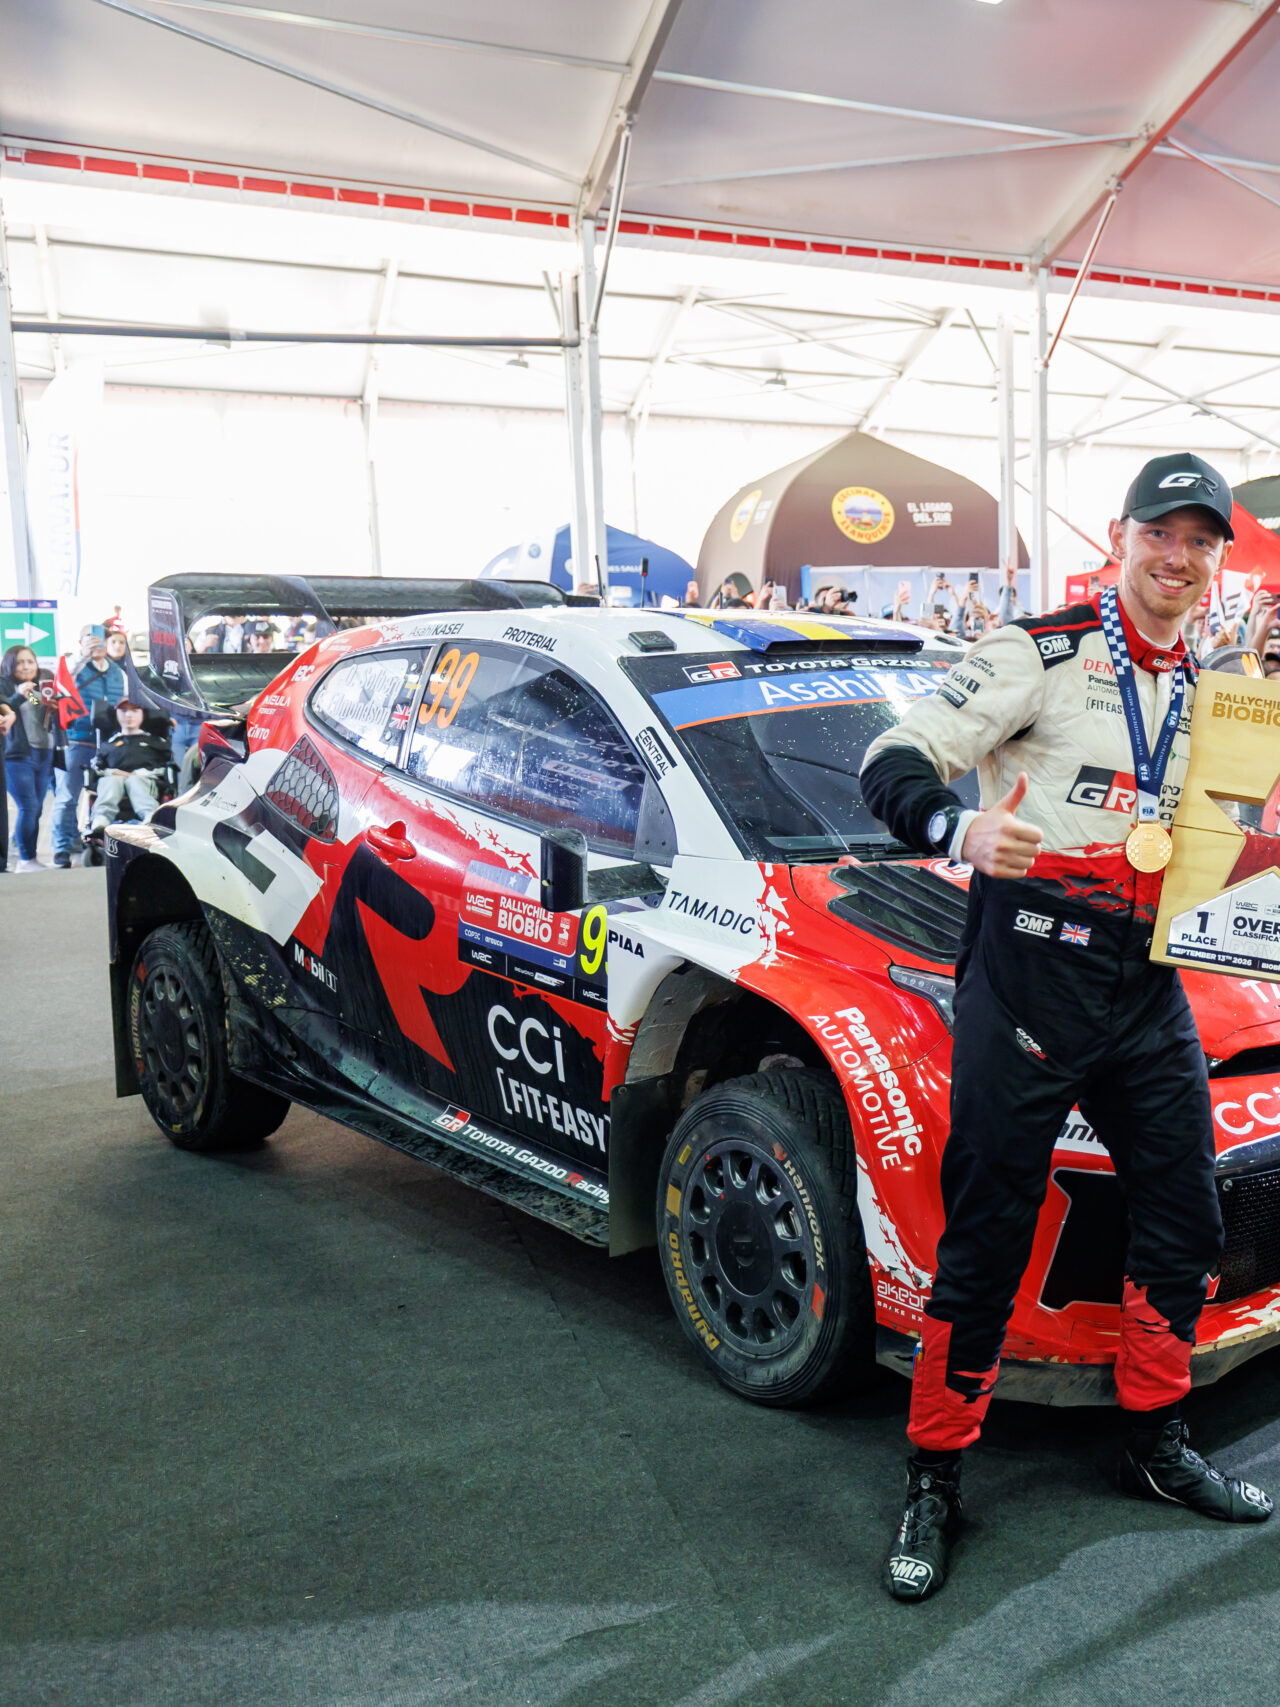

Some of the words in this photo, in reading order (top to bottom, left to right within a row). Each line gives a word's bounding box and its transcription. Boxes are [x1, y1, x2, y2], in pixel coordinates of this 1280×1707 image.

[1158, 471, 1219, 497] GR
[433, 623, 464, 635] KASEI
[502, 626, 557, 652] PROTERIAL
[1040, 636, 1072, 656] OMP
[691, 666, 739, 682] GR
[745, 659, 843, 674] TOYOTA
[850, 657, 931, 673] GAZOO
[418, 648, 480, 729] 99
[759, 673, 872, 705] Asahi
[872, 672, 953, 703] KAS
[1088, 674, 1119, 688] Panaso
[638, 729, 668, 777] CENTRAL
[1069, 781, 1137, 813] GR
[1142, 806, 1155, 816] FIA
[467, 892, 494, 911] WRC
[500, 896, 554, 923] RALLYCHILE
[668, 890, 756, 935] TAMADIC
[1015, 913, 1053, 934] OMP
[580, 905, 608, 975] 9
[608, 929, 645, 959] PIAA
[1181, 932, 1217, 947] PLACE
[294, 943, 325, 983] Mobil
[472, 949, 492, 965] WRC
[1171, 946, 1216, 962] SEPTEMBER
[808, 1014, 901, 1171] AUTOMOTIVE
[834, 1006, 923, 1157] Panasonic
[435, 1113, 463, 1131] GR
[461, 1124, 516, 1156] TOYOTA
[514, 1149, 567, 1180] GAZOO
[564, 1172, 610, 1204] Racing
[783, 1159, 826, 1272] Hankook
[876, 1301, 905, 1316] BRAKE
